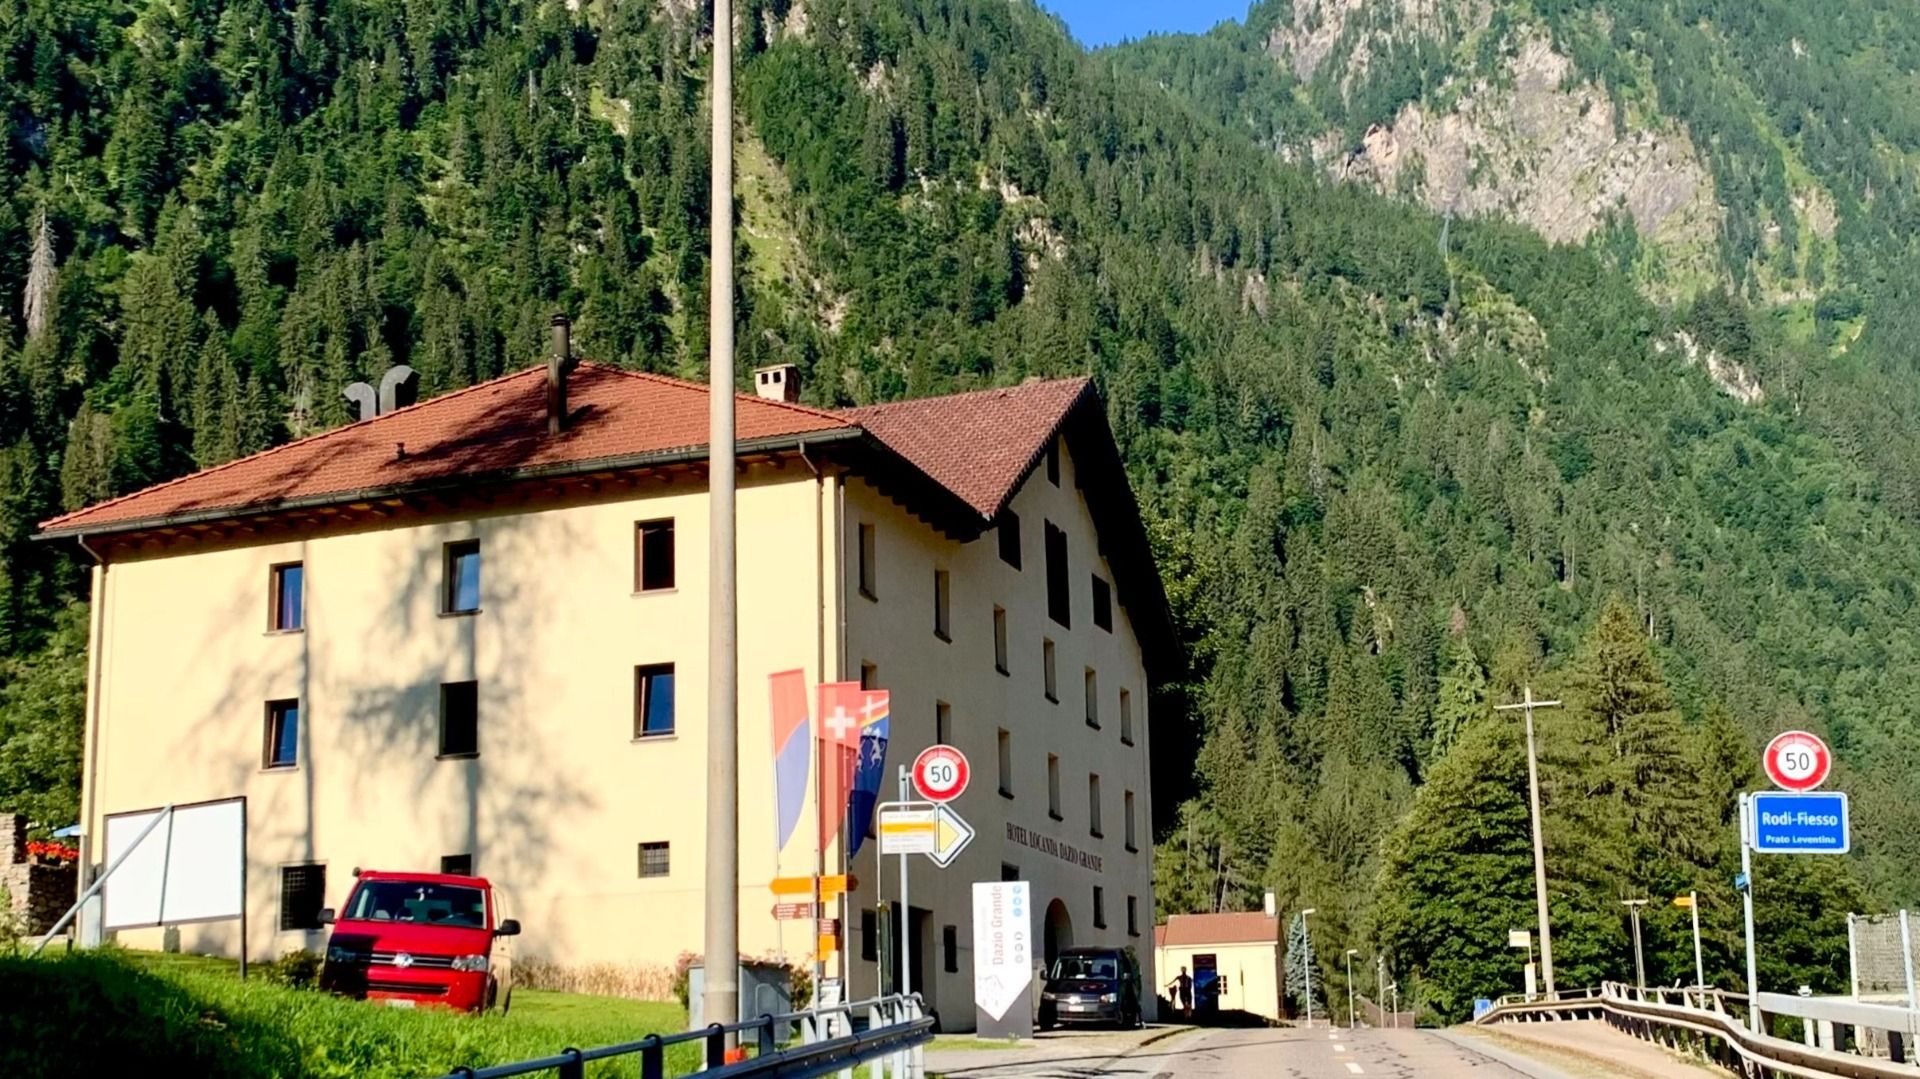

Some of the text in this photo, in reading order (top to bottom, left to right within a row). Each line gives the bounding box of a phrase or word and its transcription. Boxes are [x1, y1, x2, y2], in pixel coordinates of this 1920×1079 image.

[1786, 752, 1810, 771] 50
[931, 765, 952, 783] 50
[1762, 811, 1838, 827] Rodi-Fiesso
[1006, 822, 1103, 873] HOTEL LOCANDA DAZIO GRANDE
[1765, 835, 1837, 844] Prato Leventina
[991, 885, 1004, 965] Dazio Grande
